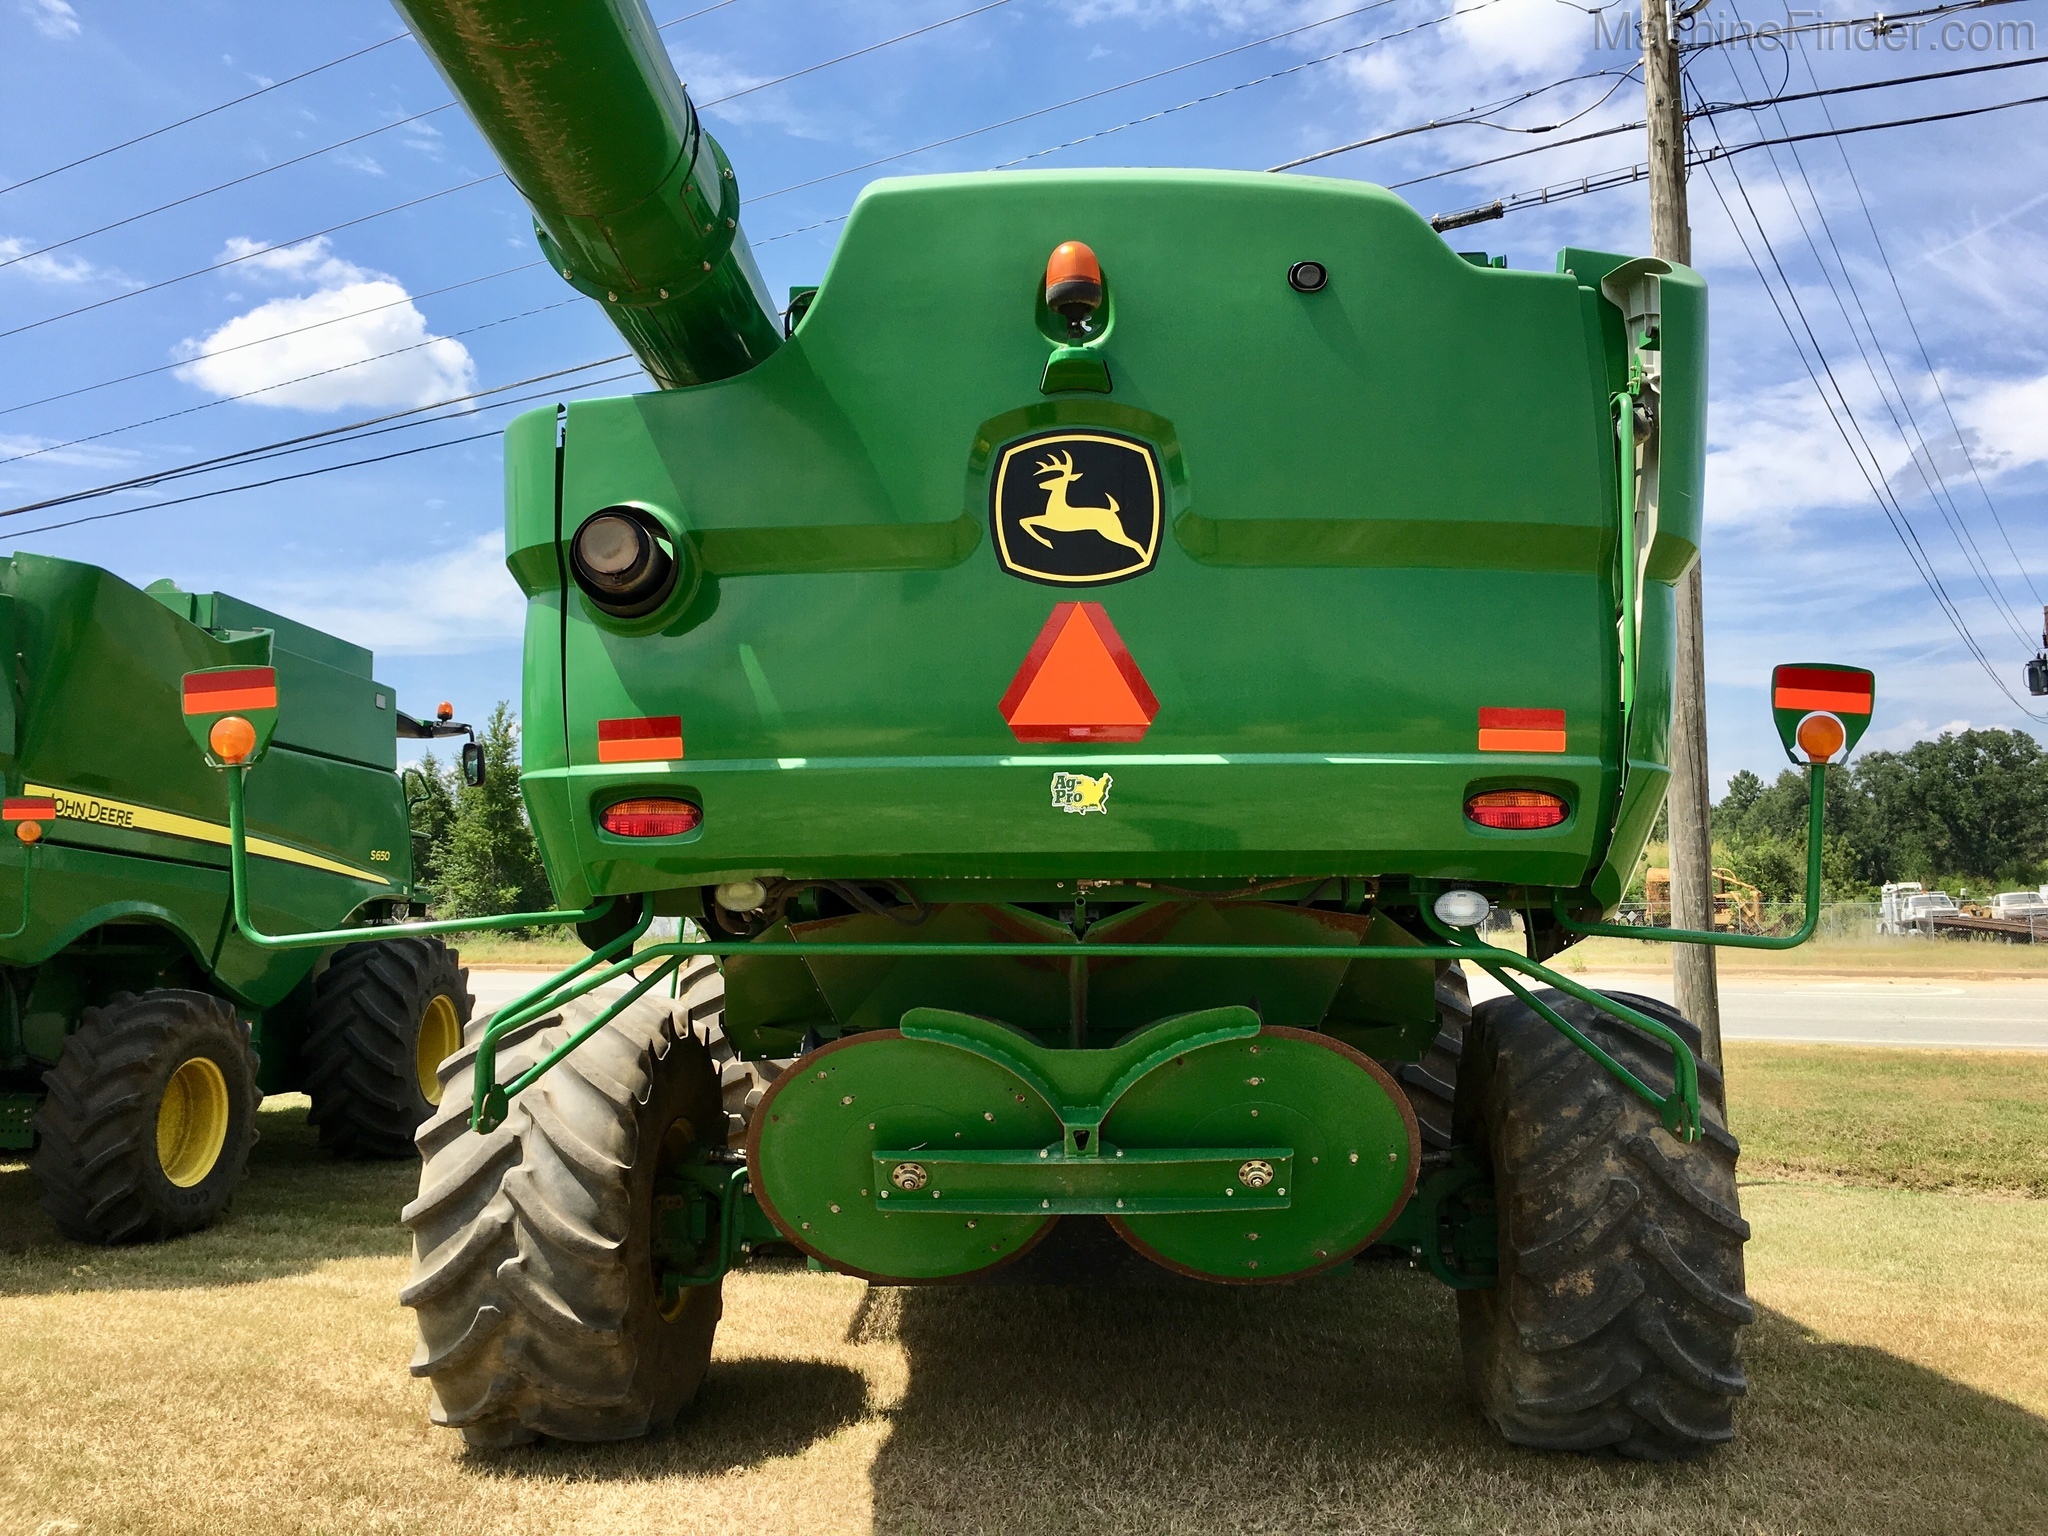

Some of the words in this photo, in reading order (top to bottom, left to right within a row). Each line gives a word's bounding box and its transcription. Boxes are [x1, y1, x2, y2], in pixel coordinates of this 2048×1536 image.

[1054, 775, 1082, 792] Ag-
[1054, 789, 1083, 803] Pro
[52, 794, 86, 816] OHN
[89, 801, 134, 826] DEERE
[370, 850, 391, 861] S650
